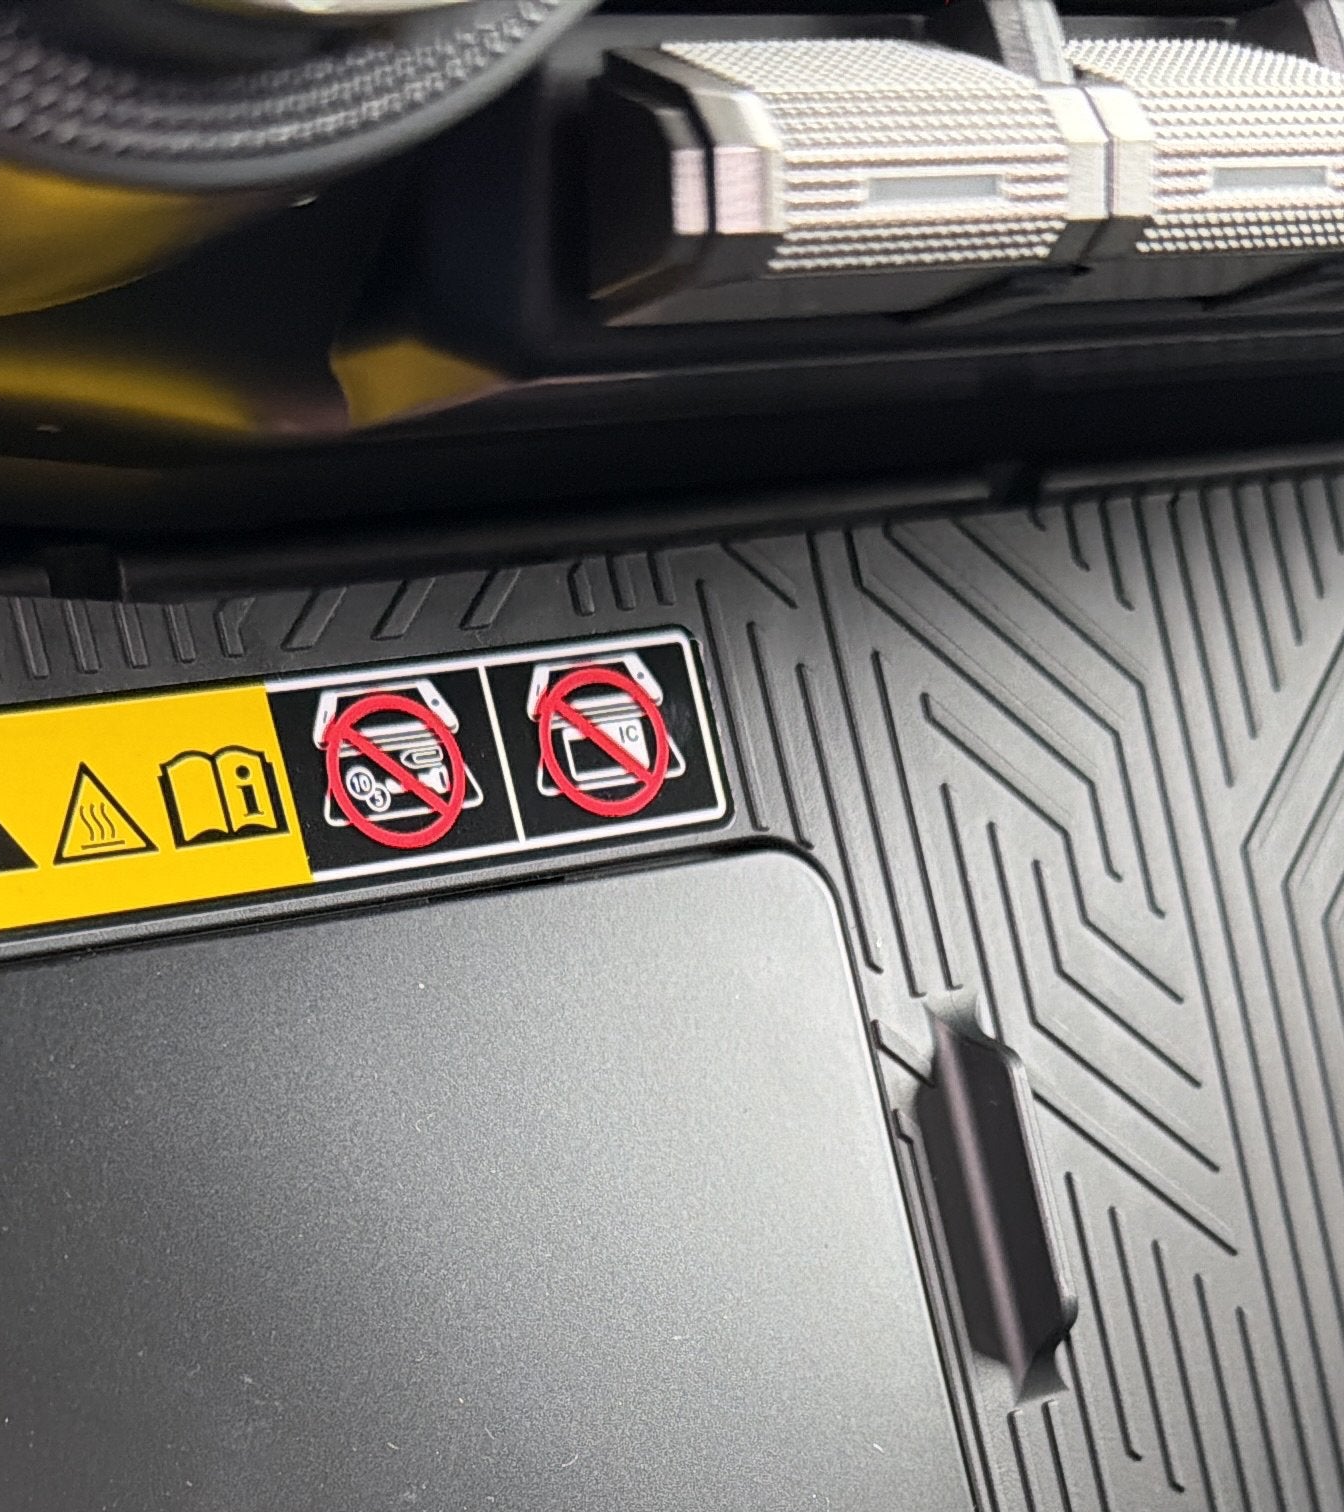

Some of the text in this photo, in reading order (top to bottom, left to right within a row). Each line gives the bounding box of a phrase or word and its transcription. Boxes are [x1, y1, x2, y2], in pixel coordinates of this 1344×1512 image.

[619, 725, 639, 743] IC
[352, 775, 371, 793] 10
[374, 790, 384, 807] 5
